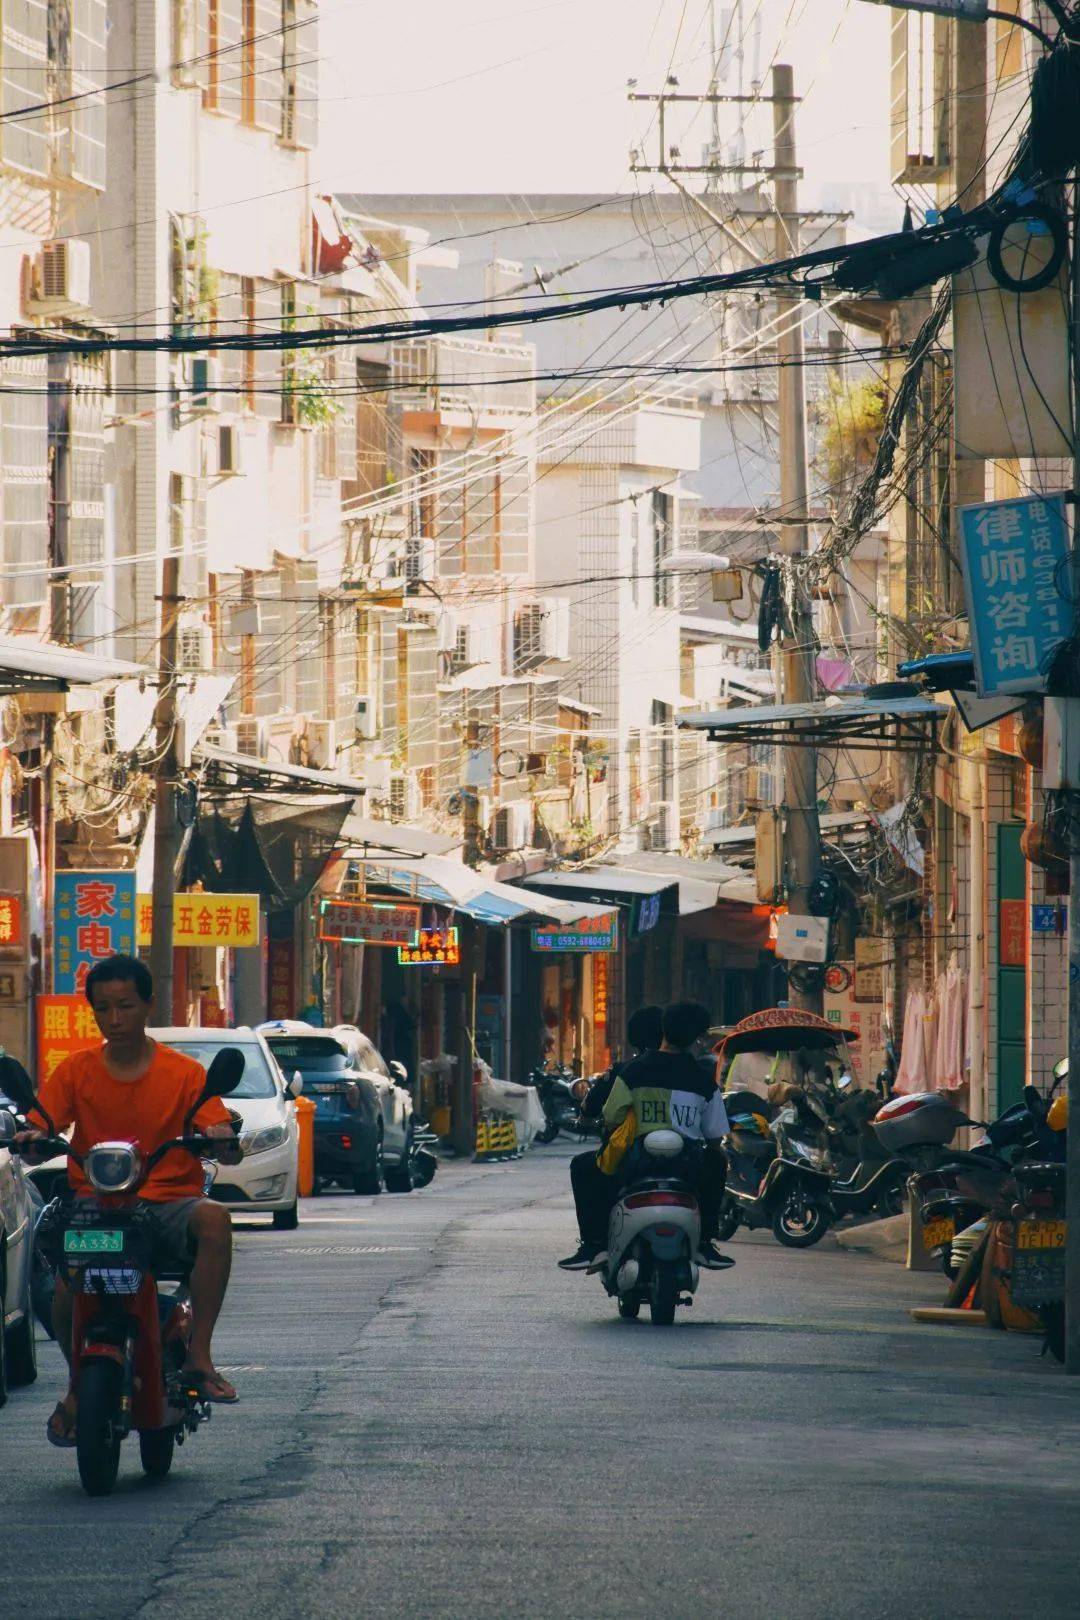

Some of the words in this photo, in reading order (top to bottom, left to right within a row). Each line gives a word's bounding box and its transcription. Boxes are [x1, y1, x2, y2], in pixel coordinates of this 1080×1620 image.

[975, 507, 1038, 672] 律师咨询
[75, 880, 118, 995] 家电
[44, 1004, 101, 1040] 照相
[641, 1101, 665, 1122] EH
[672, 1104, 698, 1128] NU
